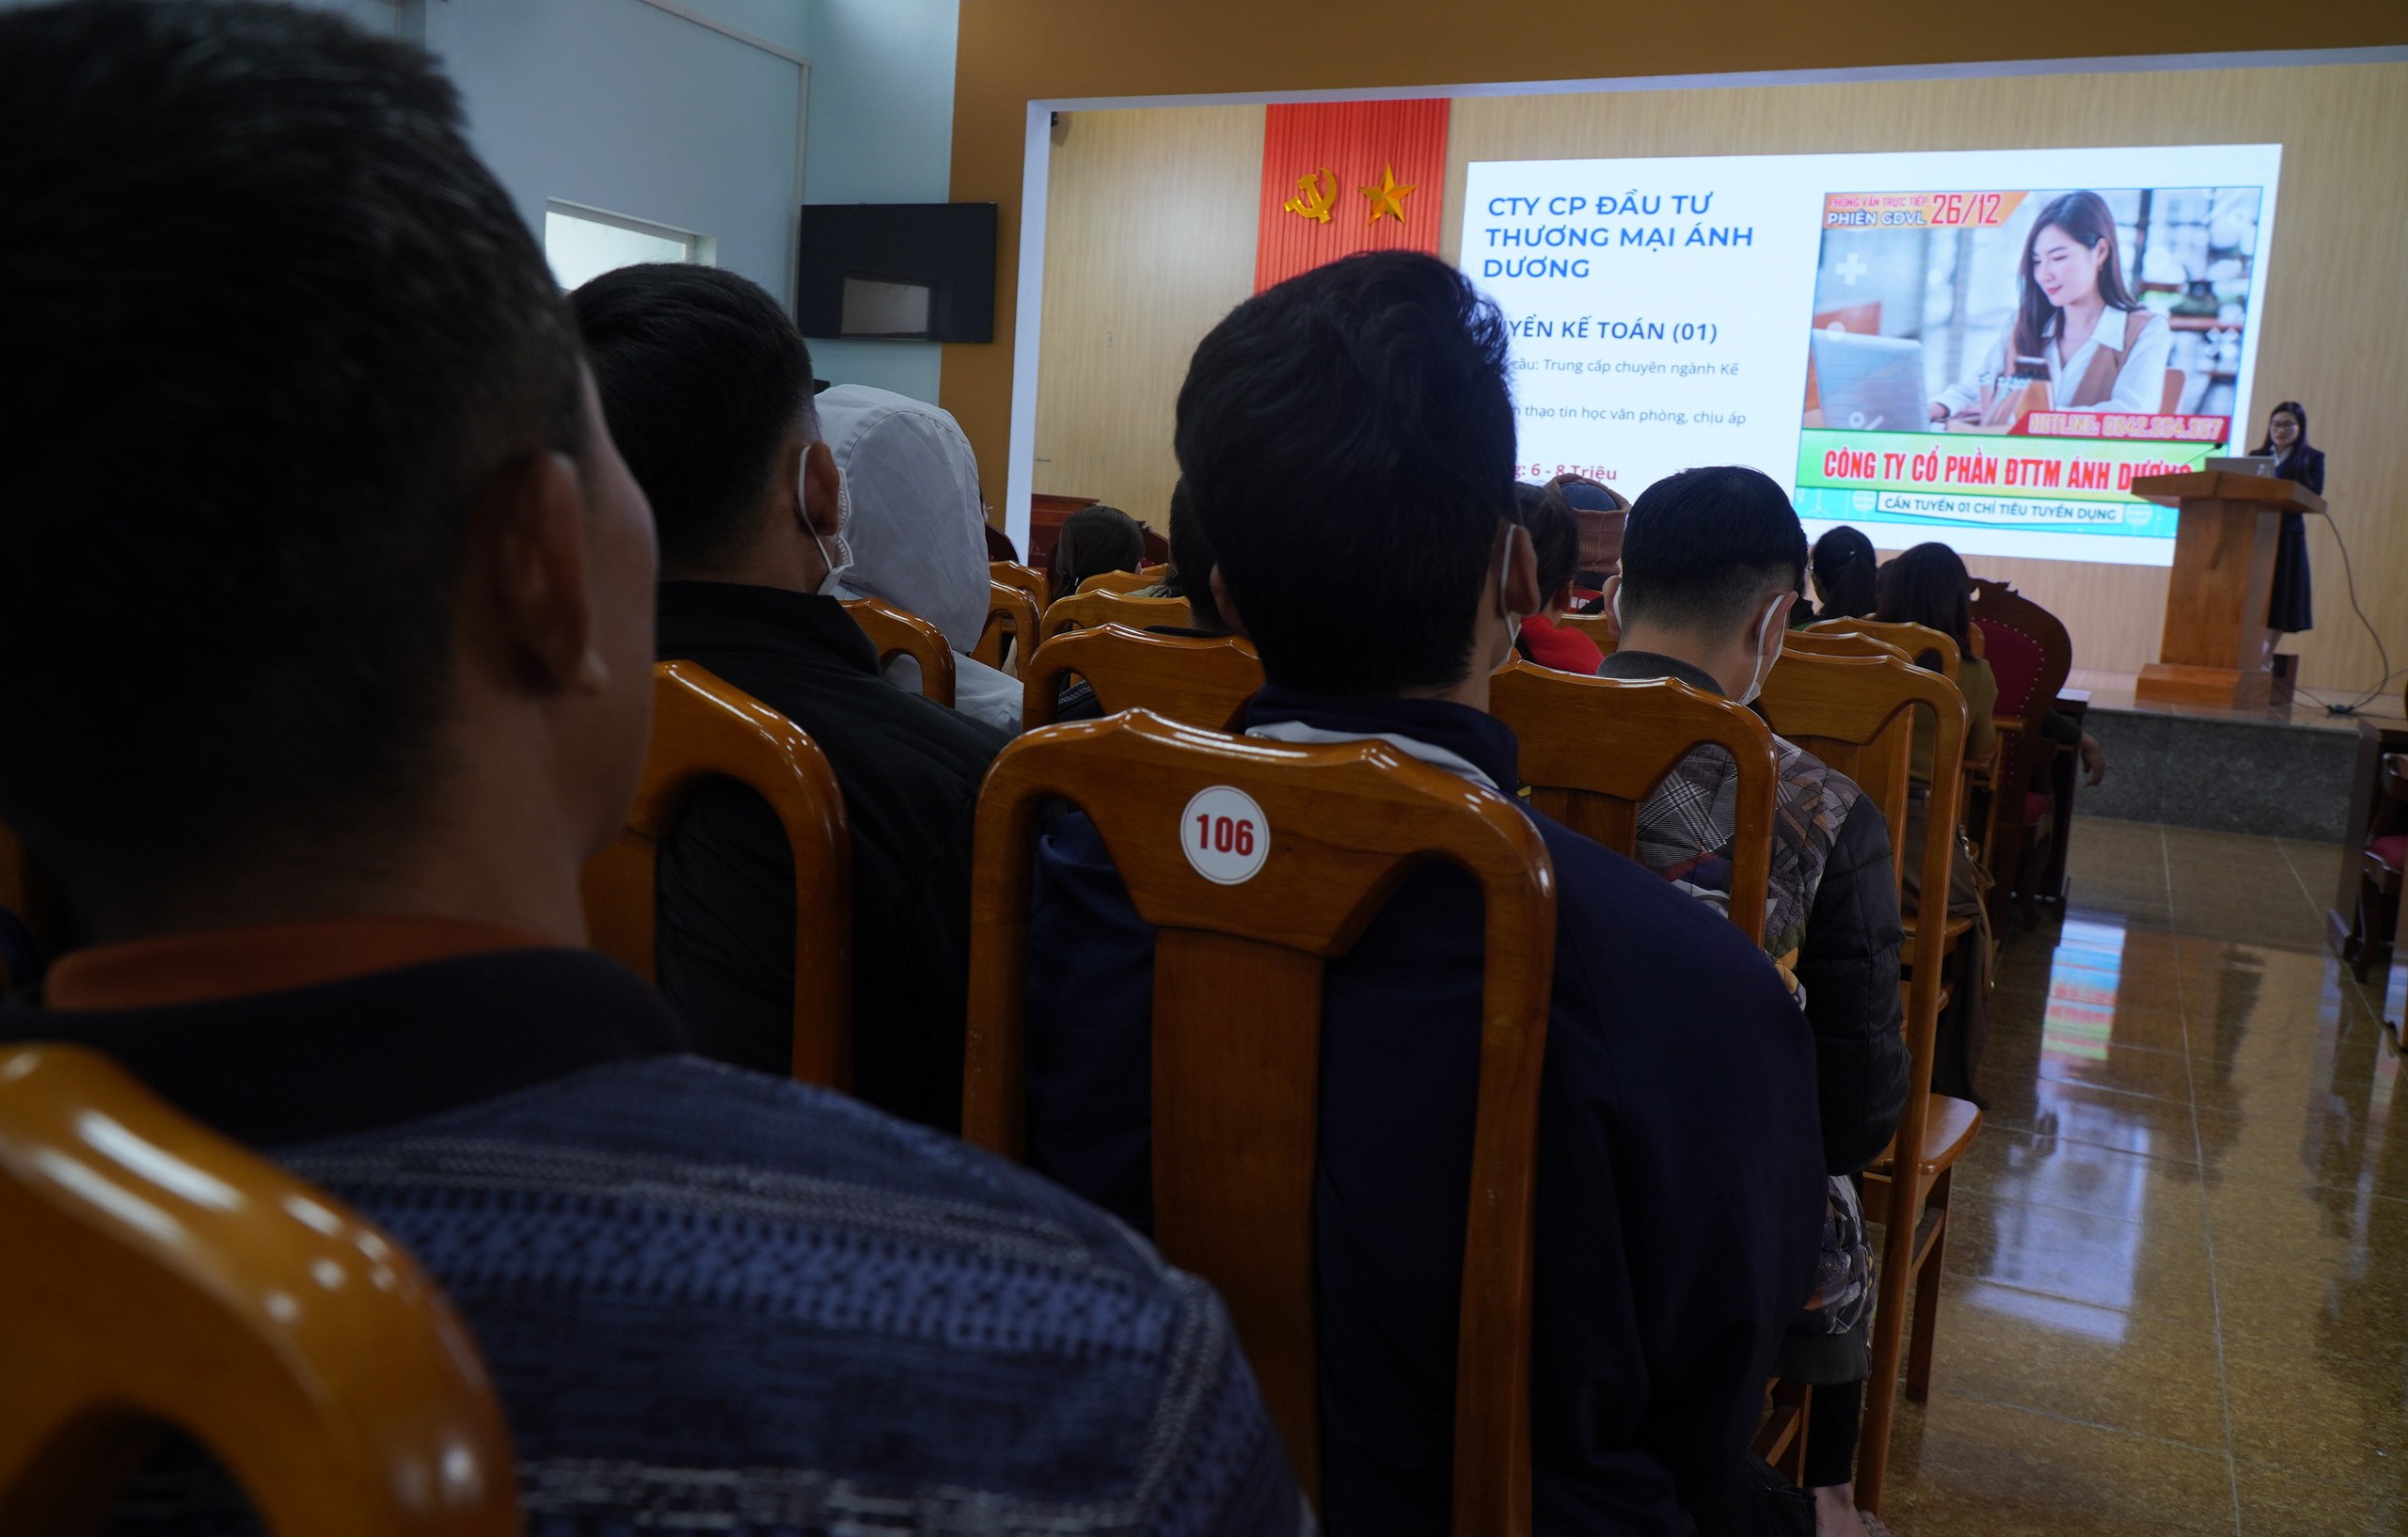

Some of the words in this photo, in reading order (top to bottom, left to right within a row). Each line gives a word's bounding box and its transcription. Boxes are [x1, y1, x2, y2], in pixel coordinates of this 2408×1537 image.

[1488, 197, 1541, 216] CTY
[1548, 196, 1587, 215] CP
[1596, 189, 1660, 215] ĐẦU
[1671, 191, 1714, 214] TƯ
[1931, 193, 2002, 225] 26/12
[1827, 208, 1877, 226] PHIÊN
[1880, 211, 1927, 226] GDVL
[1485, 225, 1609, 246] THƯƠNG
[1620, 228, 1675, 252] MẠI
[1685, 223, 1753, 246] ÁNH
[1483, 256, 1591, 277] DƯƠNG
[1561, 316, 1592, 338] KẾ
[1597, 318, 1665, 340] TOÁN
[1672, 323, 1718, 344] (01)
[1513, 358, 1540, 371] cầu:
[1543, 358, 1583, 373] Trung
[1587, 358, 1611, 374] cấp
[1615, 360, 1666, 376] chuyên
[1671, 361, 1716, 377] ngành
[1720, 361, 1739, 376] Kế
[1525, 404, 1555, 420] thạo
[1560, 406, 1576, 418] tin
[1581, 406, 1607, 421] học
[1610, 408, 1635, 420] văn
[1639, 408, 1688, 424] phòng,
[1693, 410, 1723, 426] chịu
[1728, 411, 1747, 426] áp
[1531, 464, 1541, 476] 6
[1556, 465, 1565, 476] 8
[1570, 465, 1617, 483] Triệu
[1824, 446, 1877, 479] CÔNG
[1883, 453, 1906, 480] TY
[1911, 445, 1940, 482] CỔ
[1944, 447, 1998, 484] PHẦN
[2004, 458, 2062, 487] ĐTTM
[2067, 456, 2110, 490] ÁNH
[1957, 502, 1970, 513] 01
[2000, 503, 2028, 516] TIÊU
[2077, 508, 2116, 522] DỤNG
[1196, 814, 1254, 857] 106
